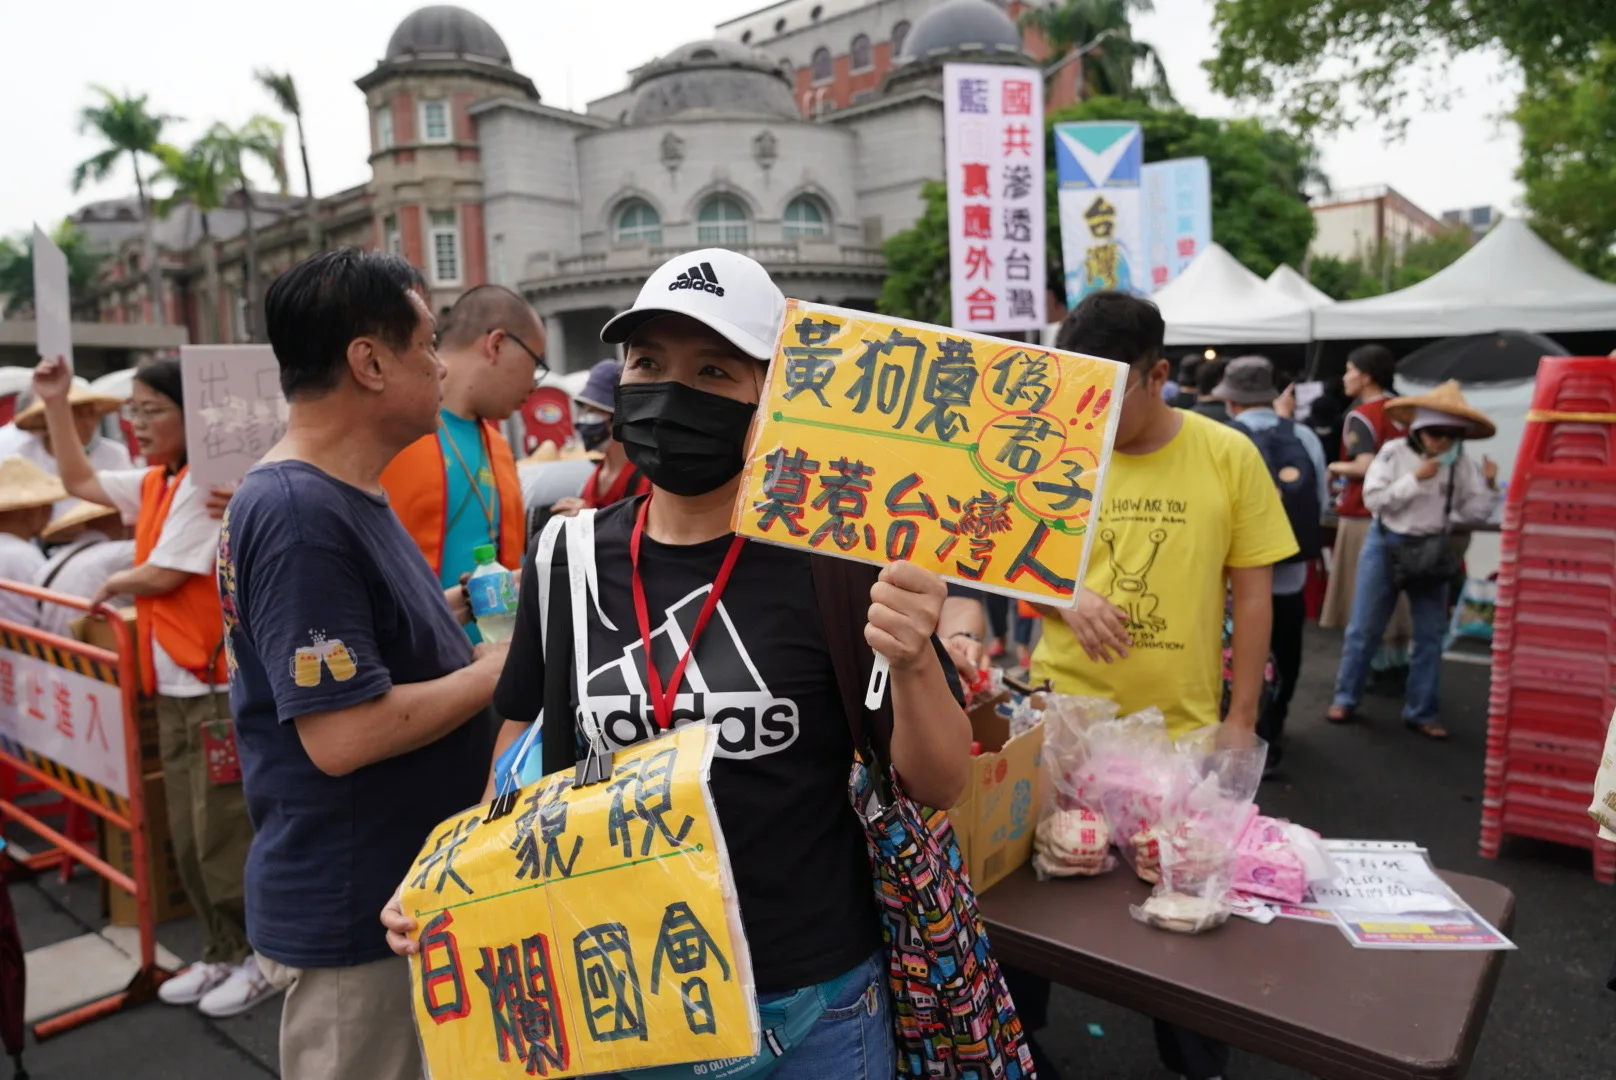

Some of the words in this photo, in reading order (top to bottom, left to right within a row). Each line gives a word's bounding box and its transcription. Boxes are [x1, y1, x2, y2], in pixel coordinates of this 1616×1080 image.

[1001, 80, 1036, 321] 國共滲透台灣
[668, 277, 725, 297] adidas
[1112, 497, 1142, 513] HOW
[1167, 499, 1187, 514] YOU
[753, 447, 1075, 595] 莫惹台灣人
[693, 1063, 708, 1075] GO
